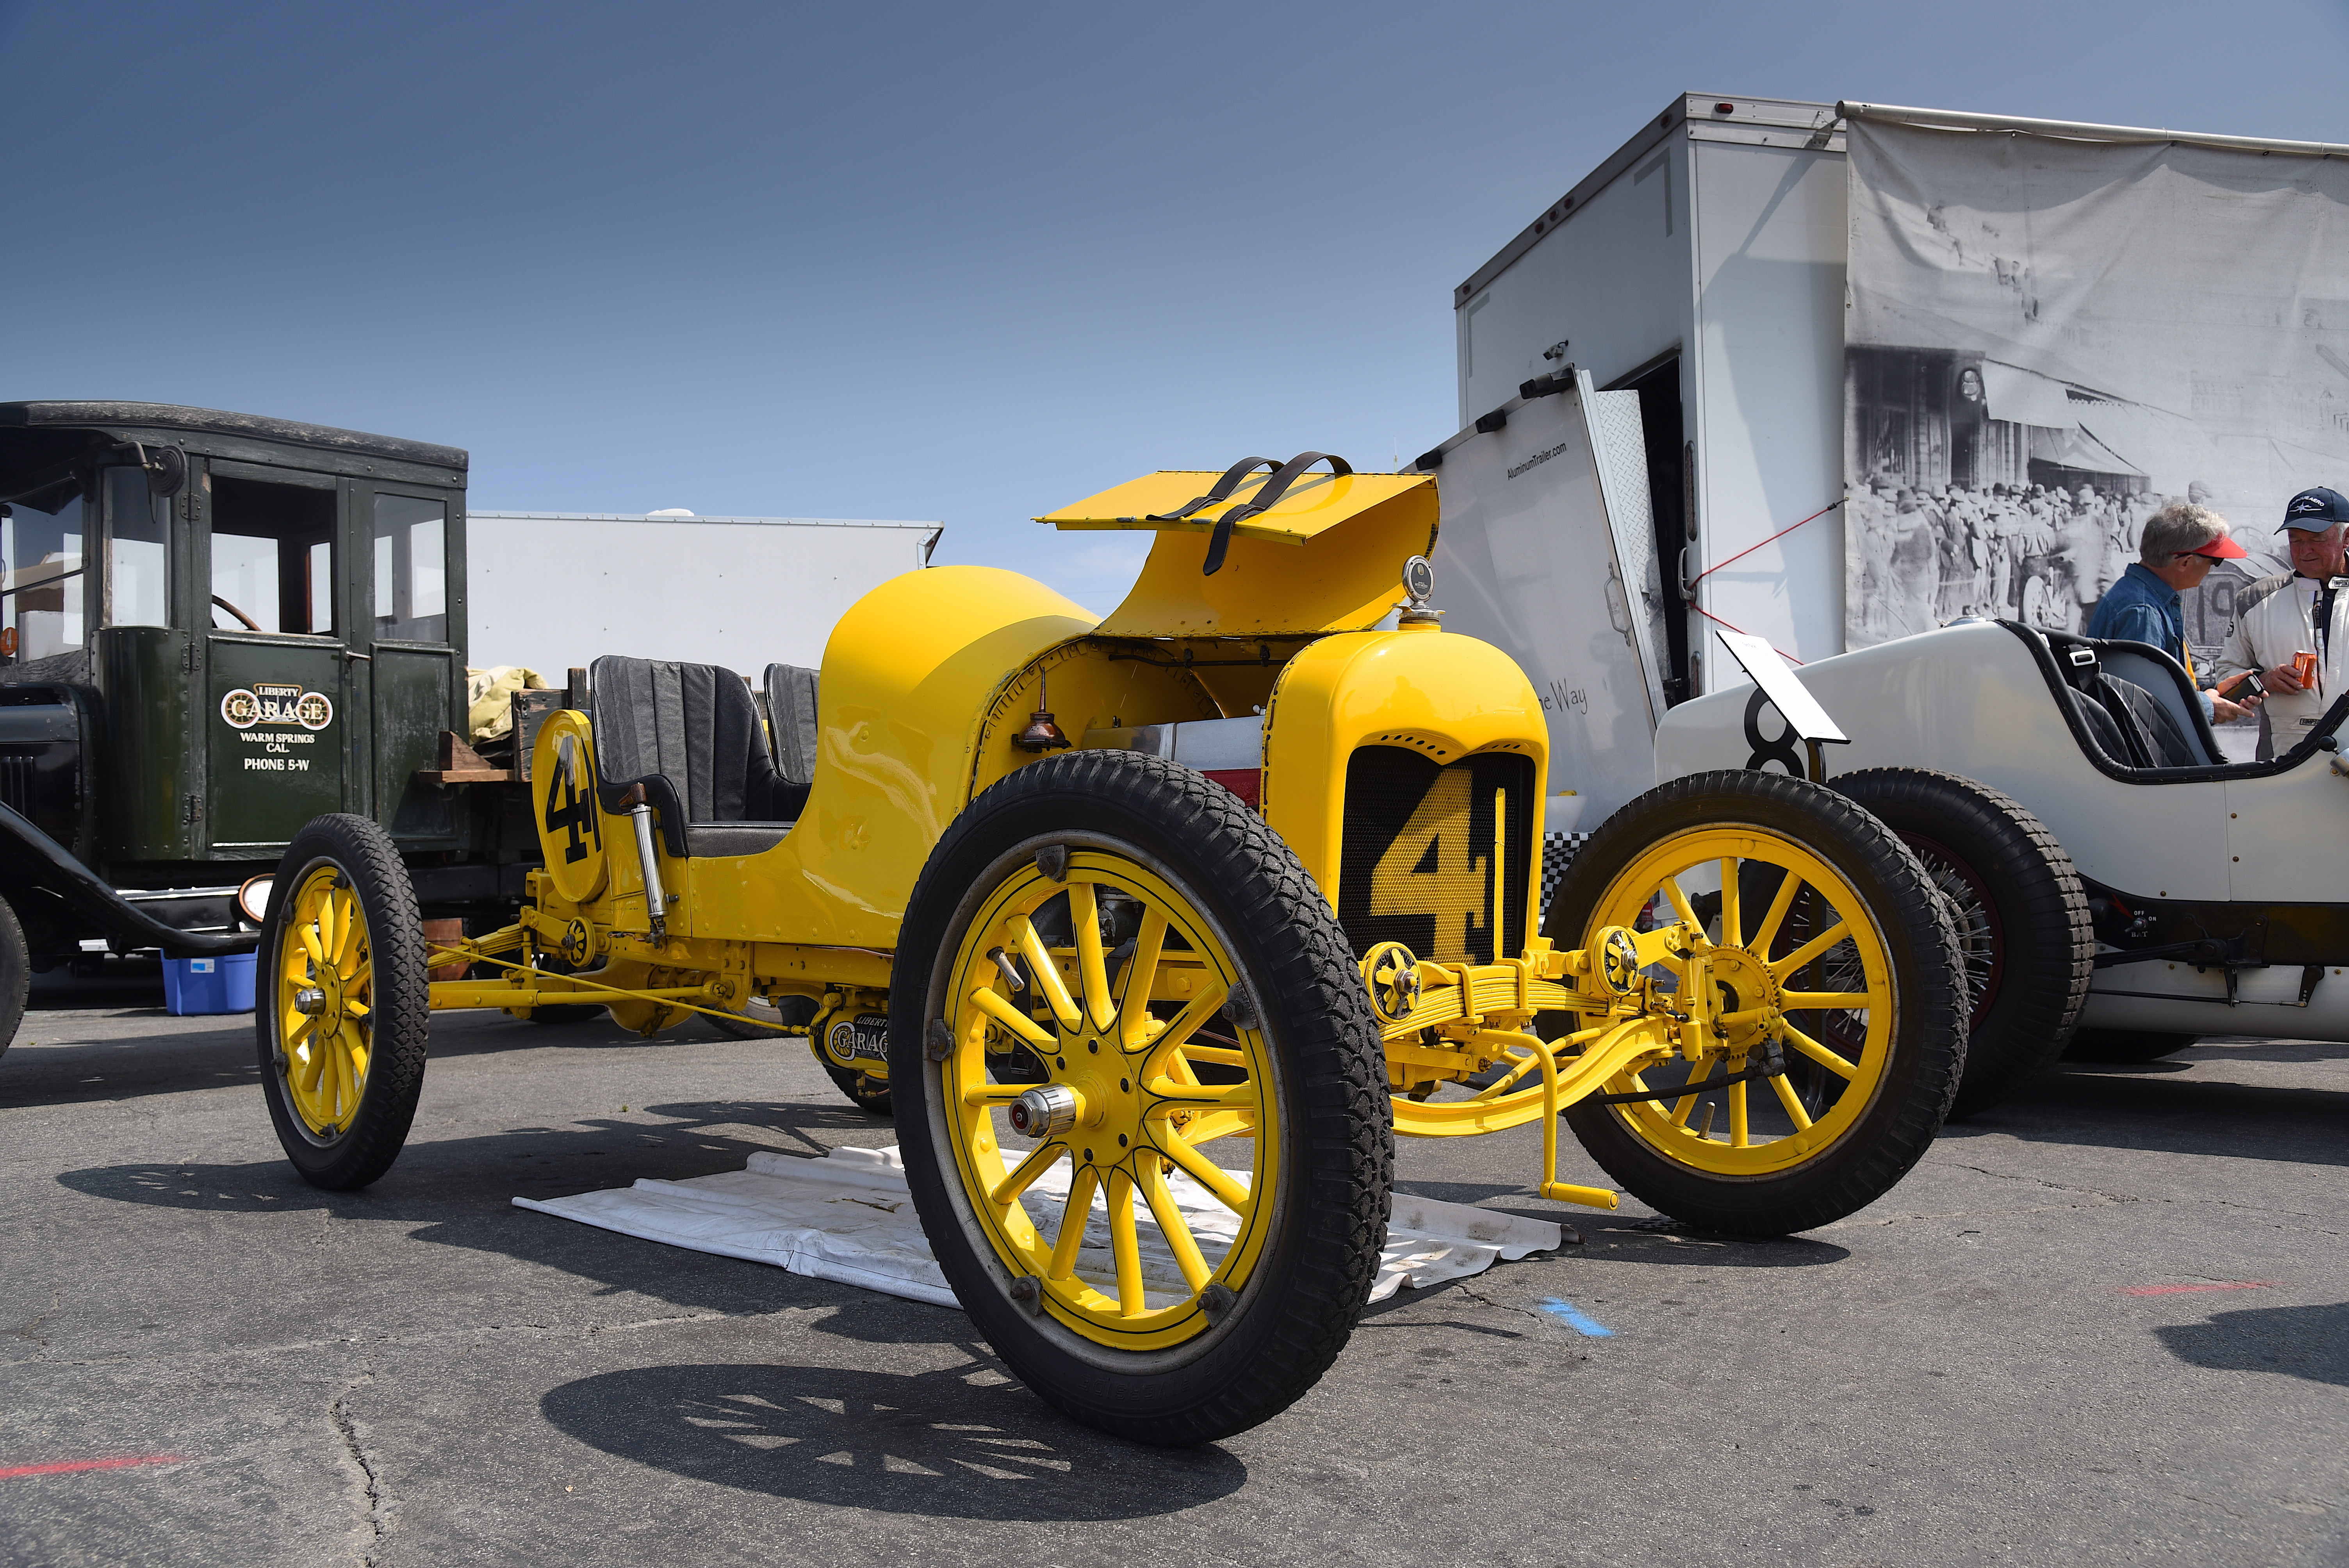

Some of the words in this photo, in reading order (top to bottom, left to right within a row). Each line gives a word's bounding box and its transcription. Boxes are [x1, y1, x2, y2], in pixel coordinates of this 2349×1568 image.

[1507, 442, 1567, 481] AluminumTrailer.com
[6, 629, 12, 649] 4
[258, 686, 299, 697] LIBERTY
[1551, 678, 1587, 715] Way
[231, 699, 323, 720] GARAGE
[240, 732, 274, 743] WARM
[276, 733, 315, 744] SPRINGS
[1744, 686, 1805, 780] 8
[244, 757, 285, 771] PHONE
[288, 759, 310, 772] 5-W
[838, 1030, 888, 1053] GARAG
[1078, 1373, 1192, 1401] RIVERSIDE
